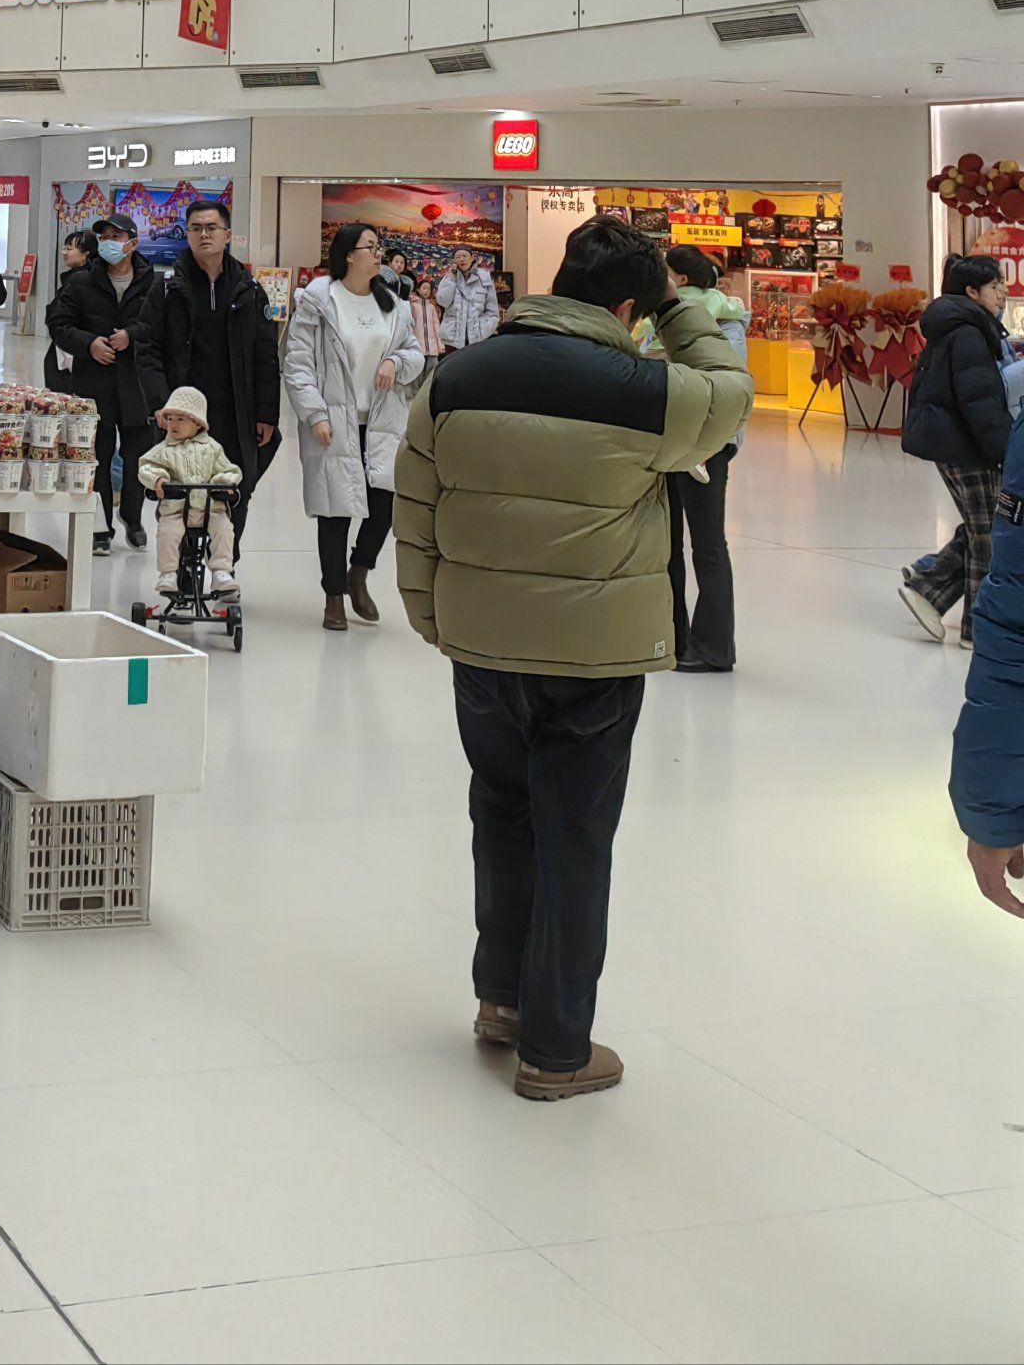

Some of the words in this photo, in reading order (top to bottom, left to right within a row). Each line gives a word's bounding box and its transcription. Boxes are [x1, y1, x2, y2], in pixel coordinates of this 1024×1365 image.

[497, 136, 534, 154] LEGO
[88, 144, 148, 169] BYD
[541, 199, 585, 213] 授权专卖店
